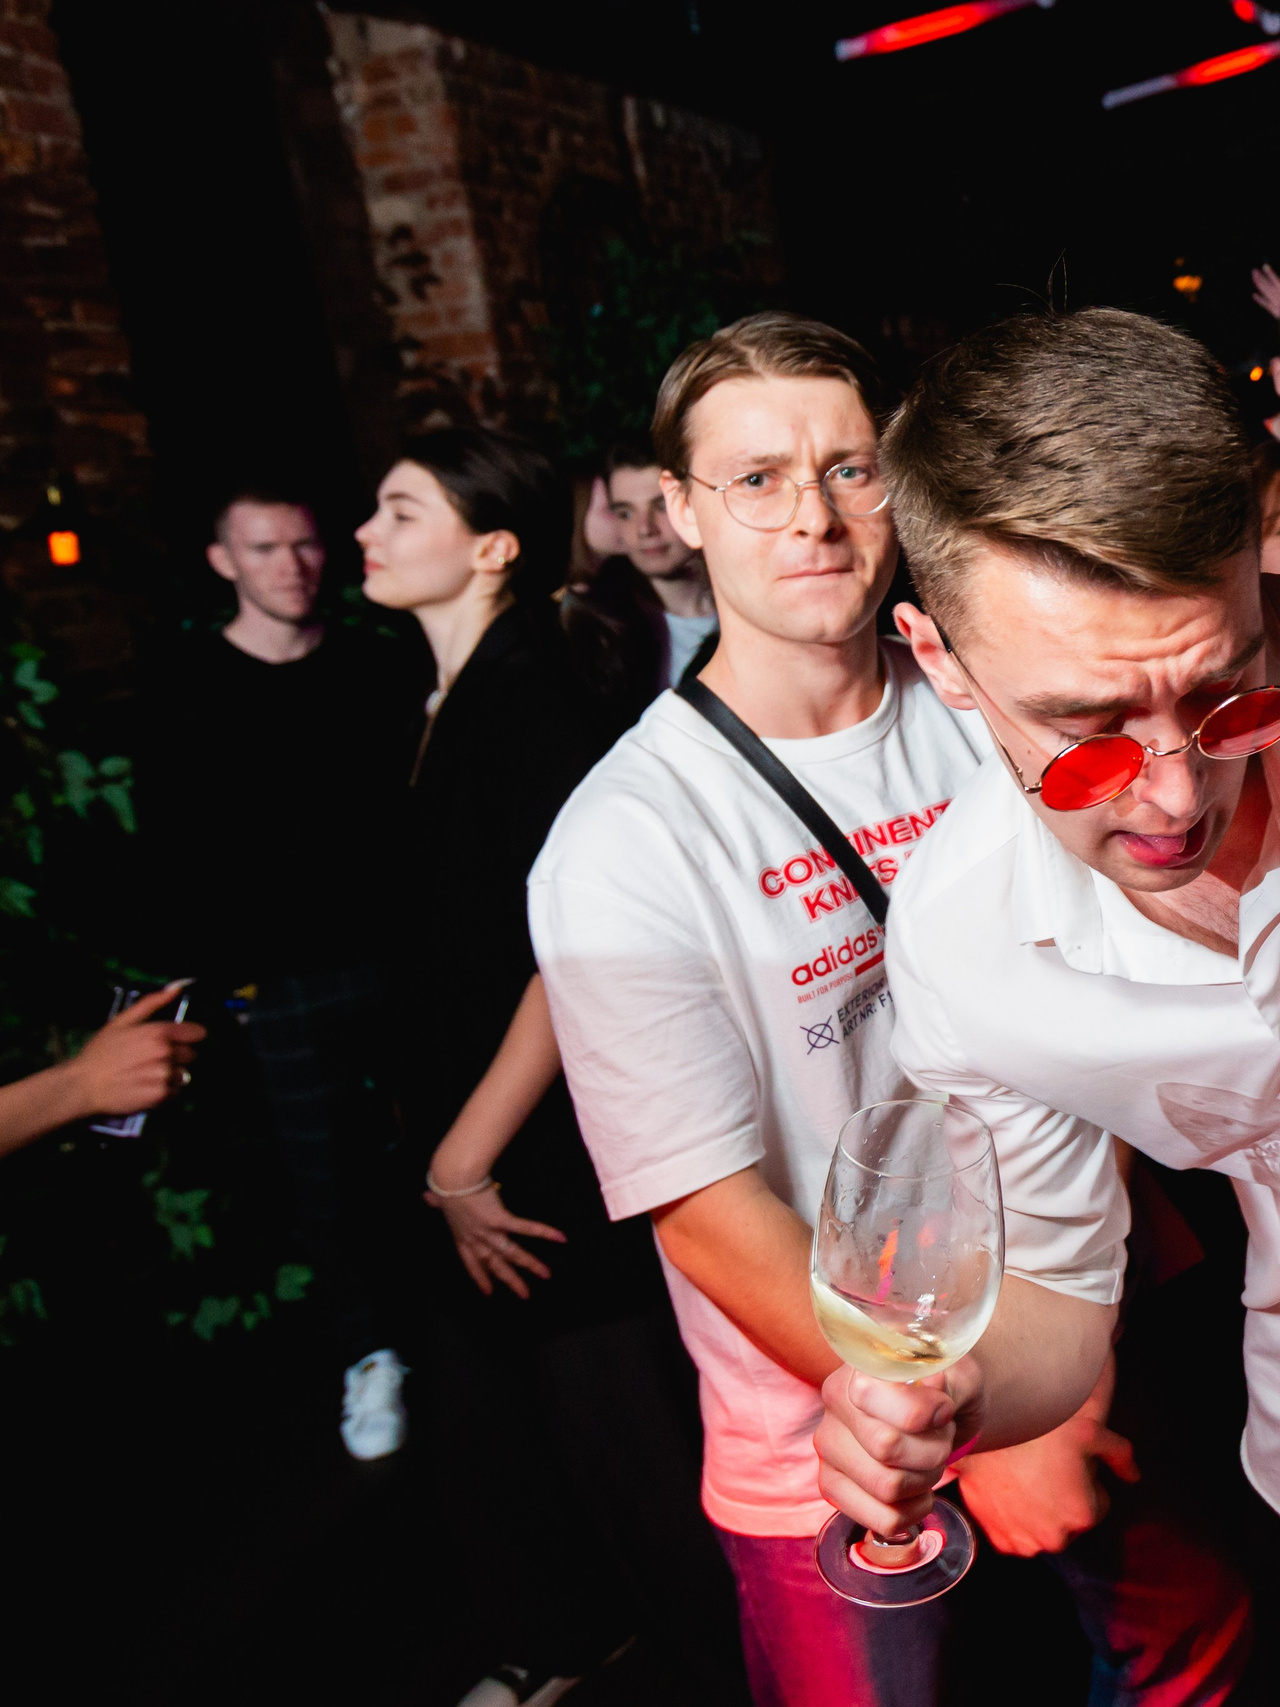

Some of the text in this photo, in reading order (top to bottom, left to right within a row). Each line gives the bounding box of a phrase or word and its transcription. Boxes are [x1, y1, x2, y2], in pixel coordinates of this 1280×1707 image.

[758, 797, 955, 899] CONINEN
[800, 857, 899, 923] KNS
[791, 928, 878, 986] adidas
[797, 990, 816, 1004] BUILT
[816, 984, 829, 996] FOR
